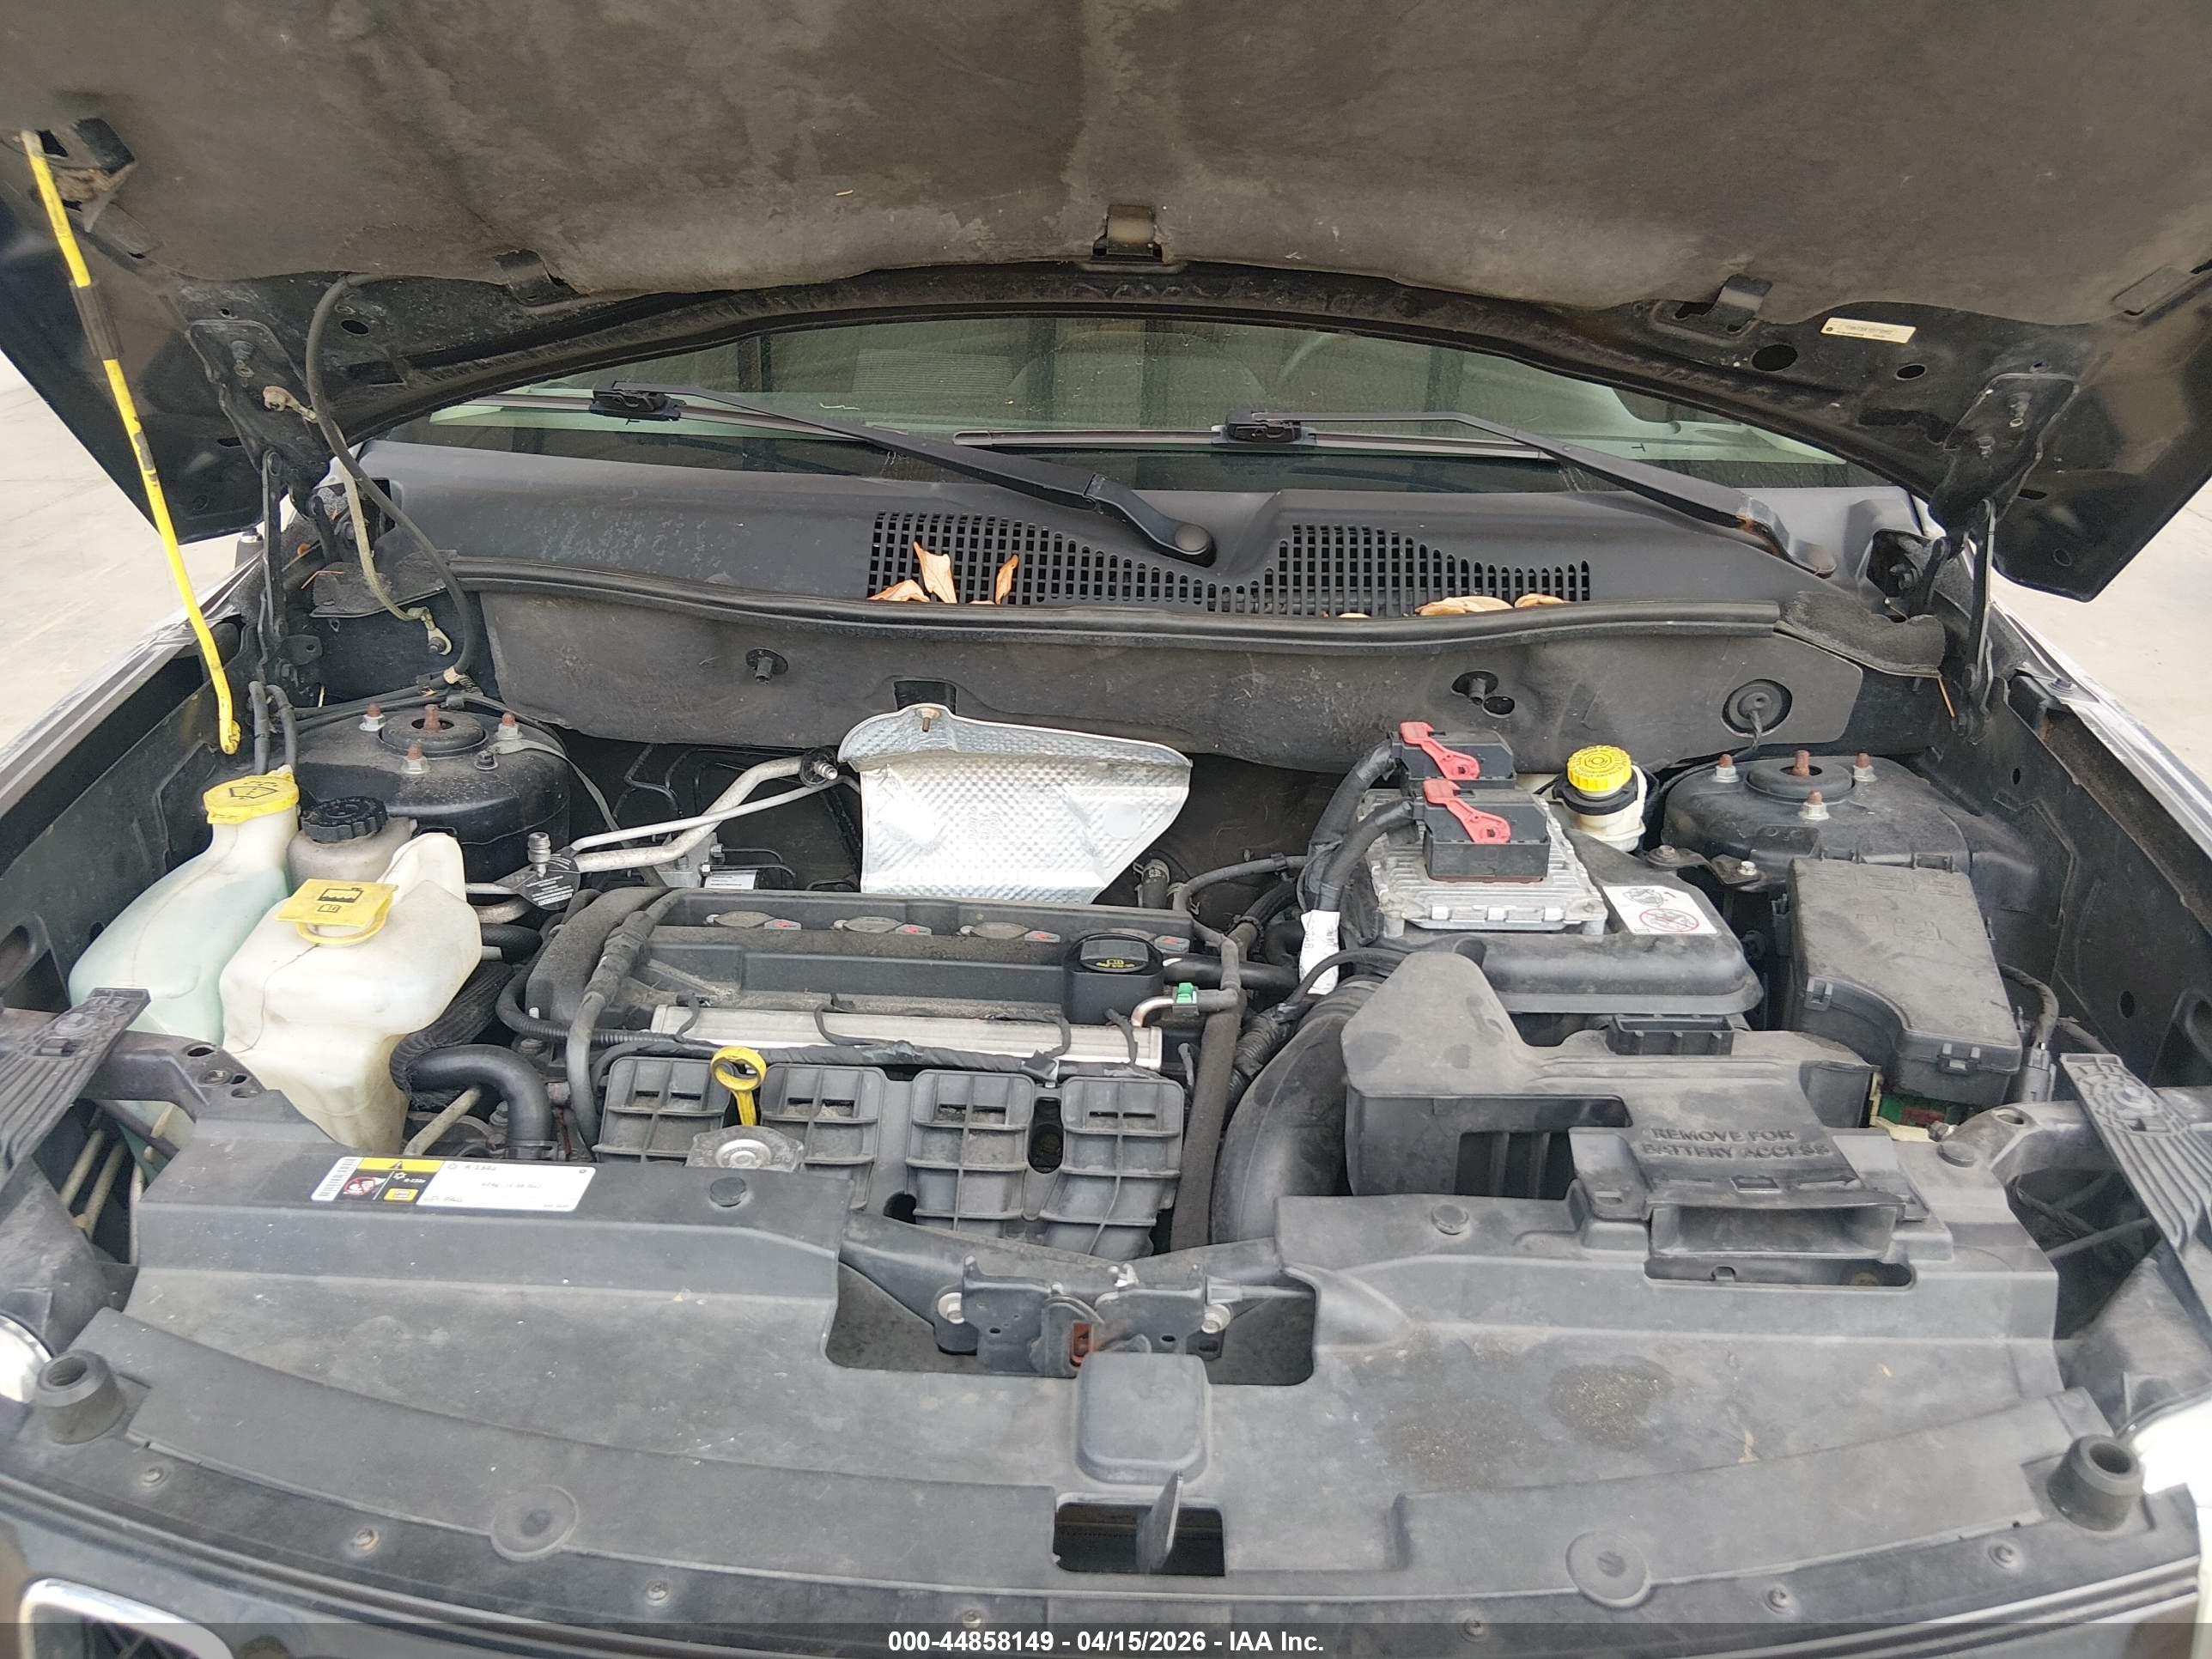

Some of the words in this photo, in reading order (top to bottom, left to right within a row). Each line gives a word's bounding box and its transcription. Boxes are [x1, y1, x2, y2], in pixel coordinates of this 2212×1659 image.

[1650, 1127, 1745, 1143] REMOVE
[1747, 1129, 1795, 1143] FOR
[1641, 1143, 1734, 1159] BATTERY
[1744, 1144, 1832, 1158] ACCESS
